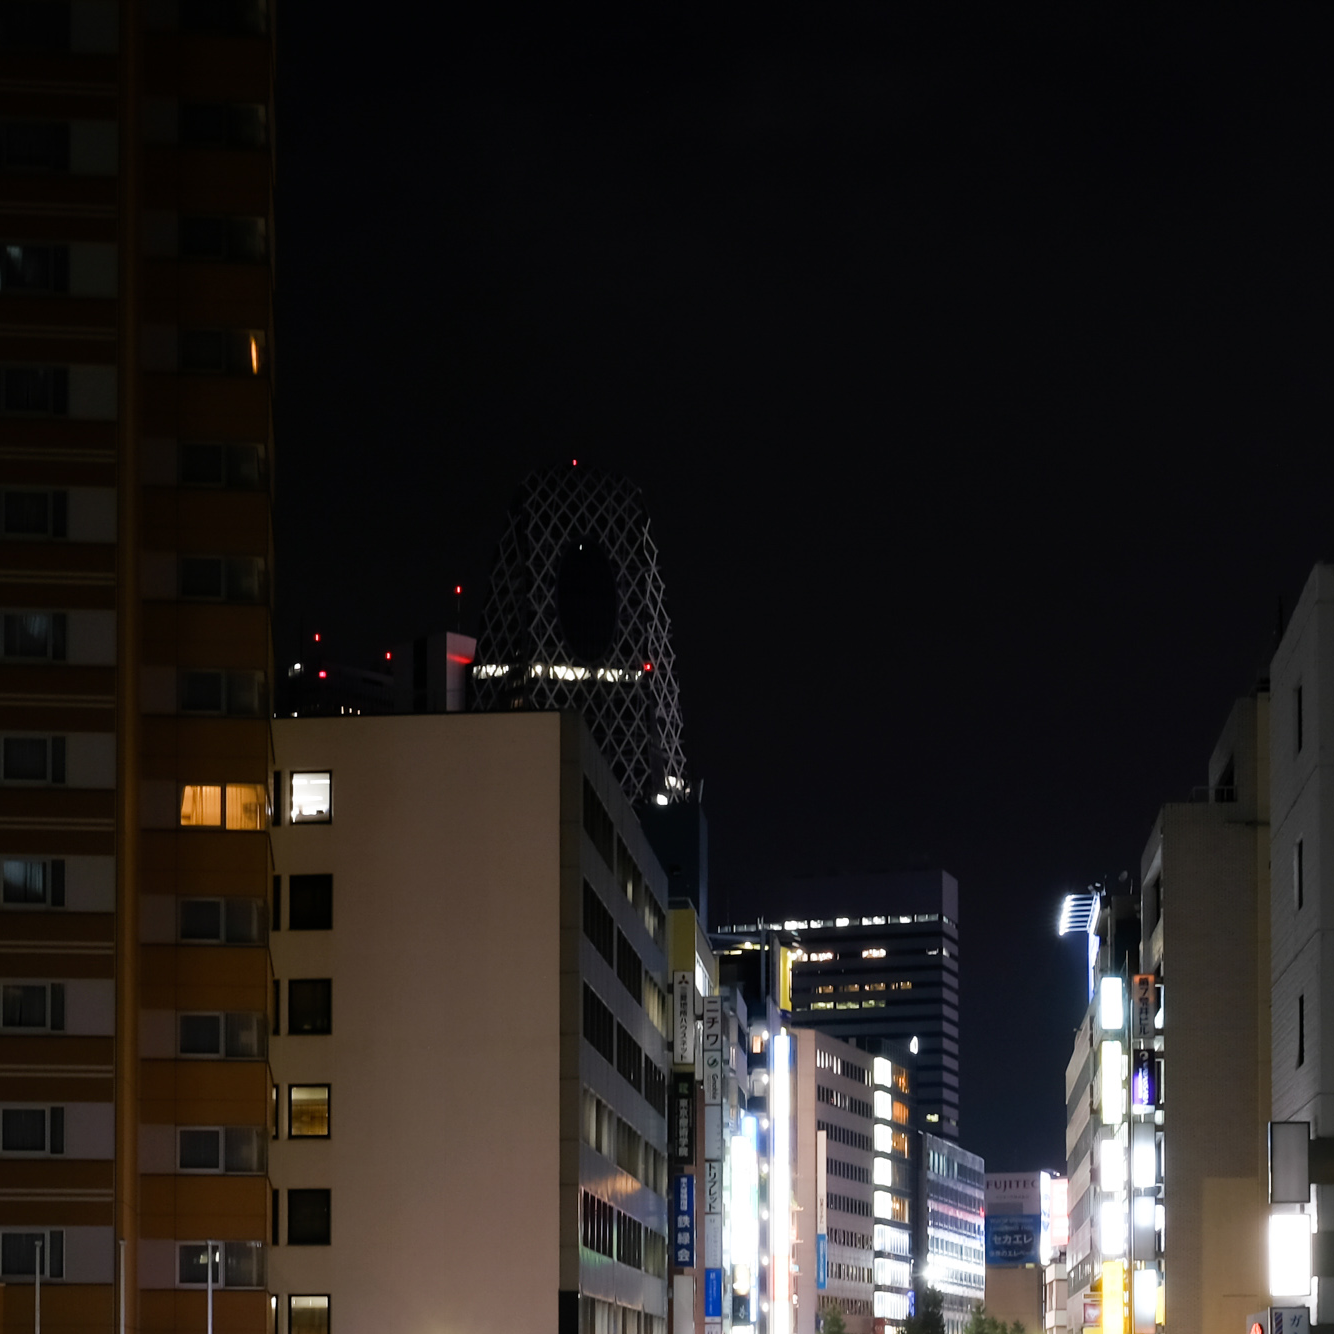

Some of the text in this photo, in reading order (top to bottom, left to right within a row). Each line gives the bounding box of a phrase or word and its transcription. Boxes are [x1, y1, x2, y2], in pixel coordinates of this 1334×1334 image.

[706, 1000, 719, 1046] ニチワ
[986, 1179, 1037, 1192] FUJITEC
[677, 1214, 690, 1262] 鉄緑会
[992, 1234, 1033, 1245] セカエレ
